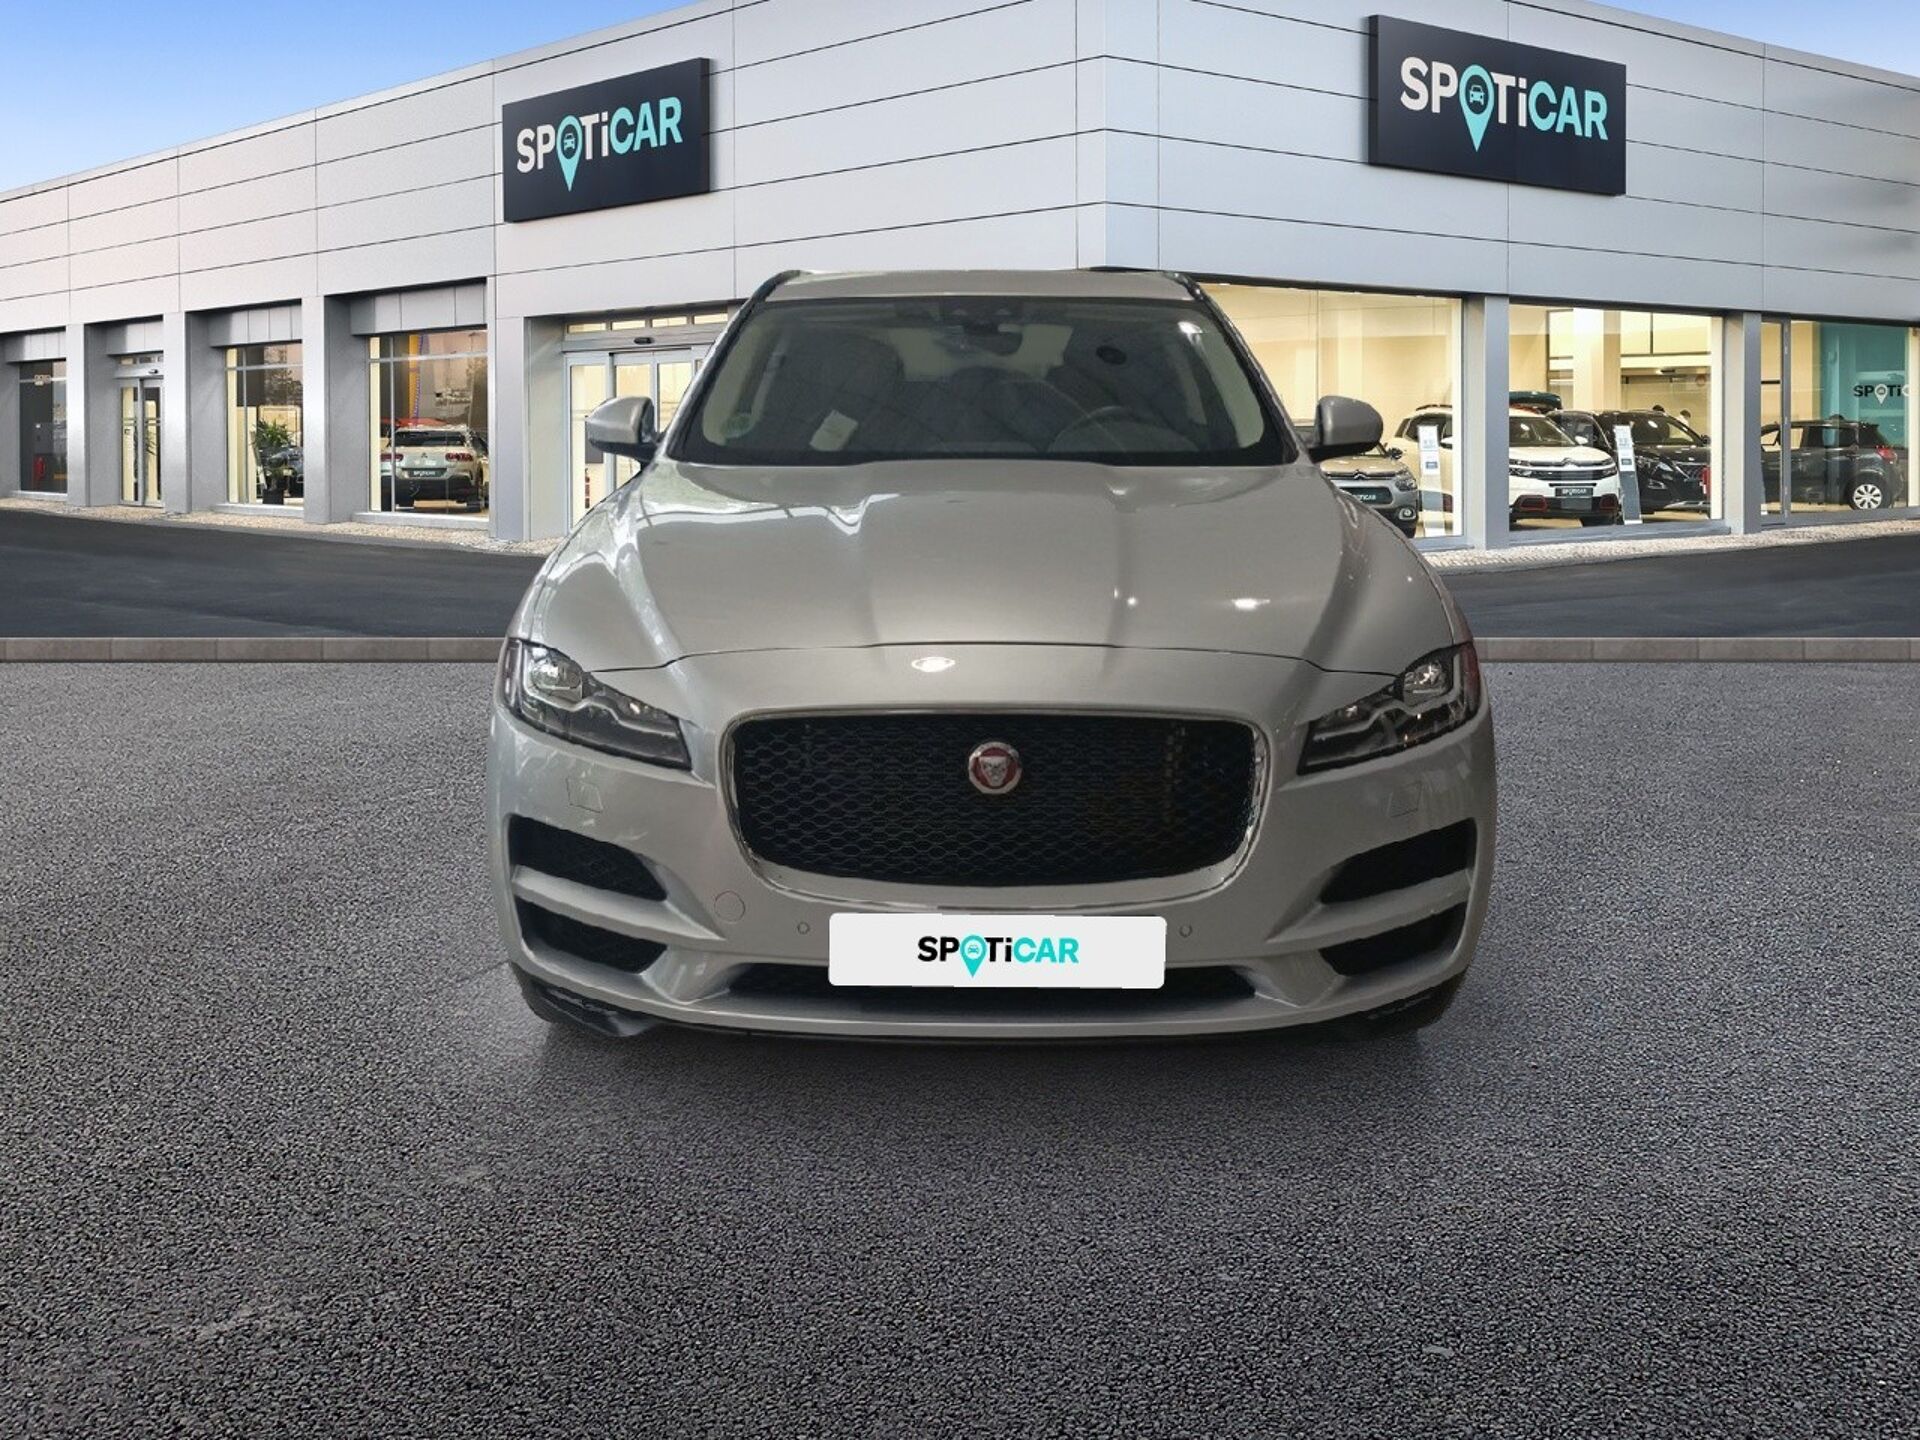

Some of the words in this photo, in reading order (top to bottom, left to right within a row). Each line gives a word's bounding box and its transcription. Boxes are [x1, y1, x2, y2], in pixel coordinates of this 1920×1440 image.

[516, 96, 683, 192] SPOTiCAR
[1400, 56, 1608, 152] SPOTiCAR
[917, 934, 1079, 978] SPOTiCAR
